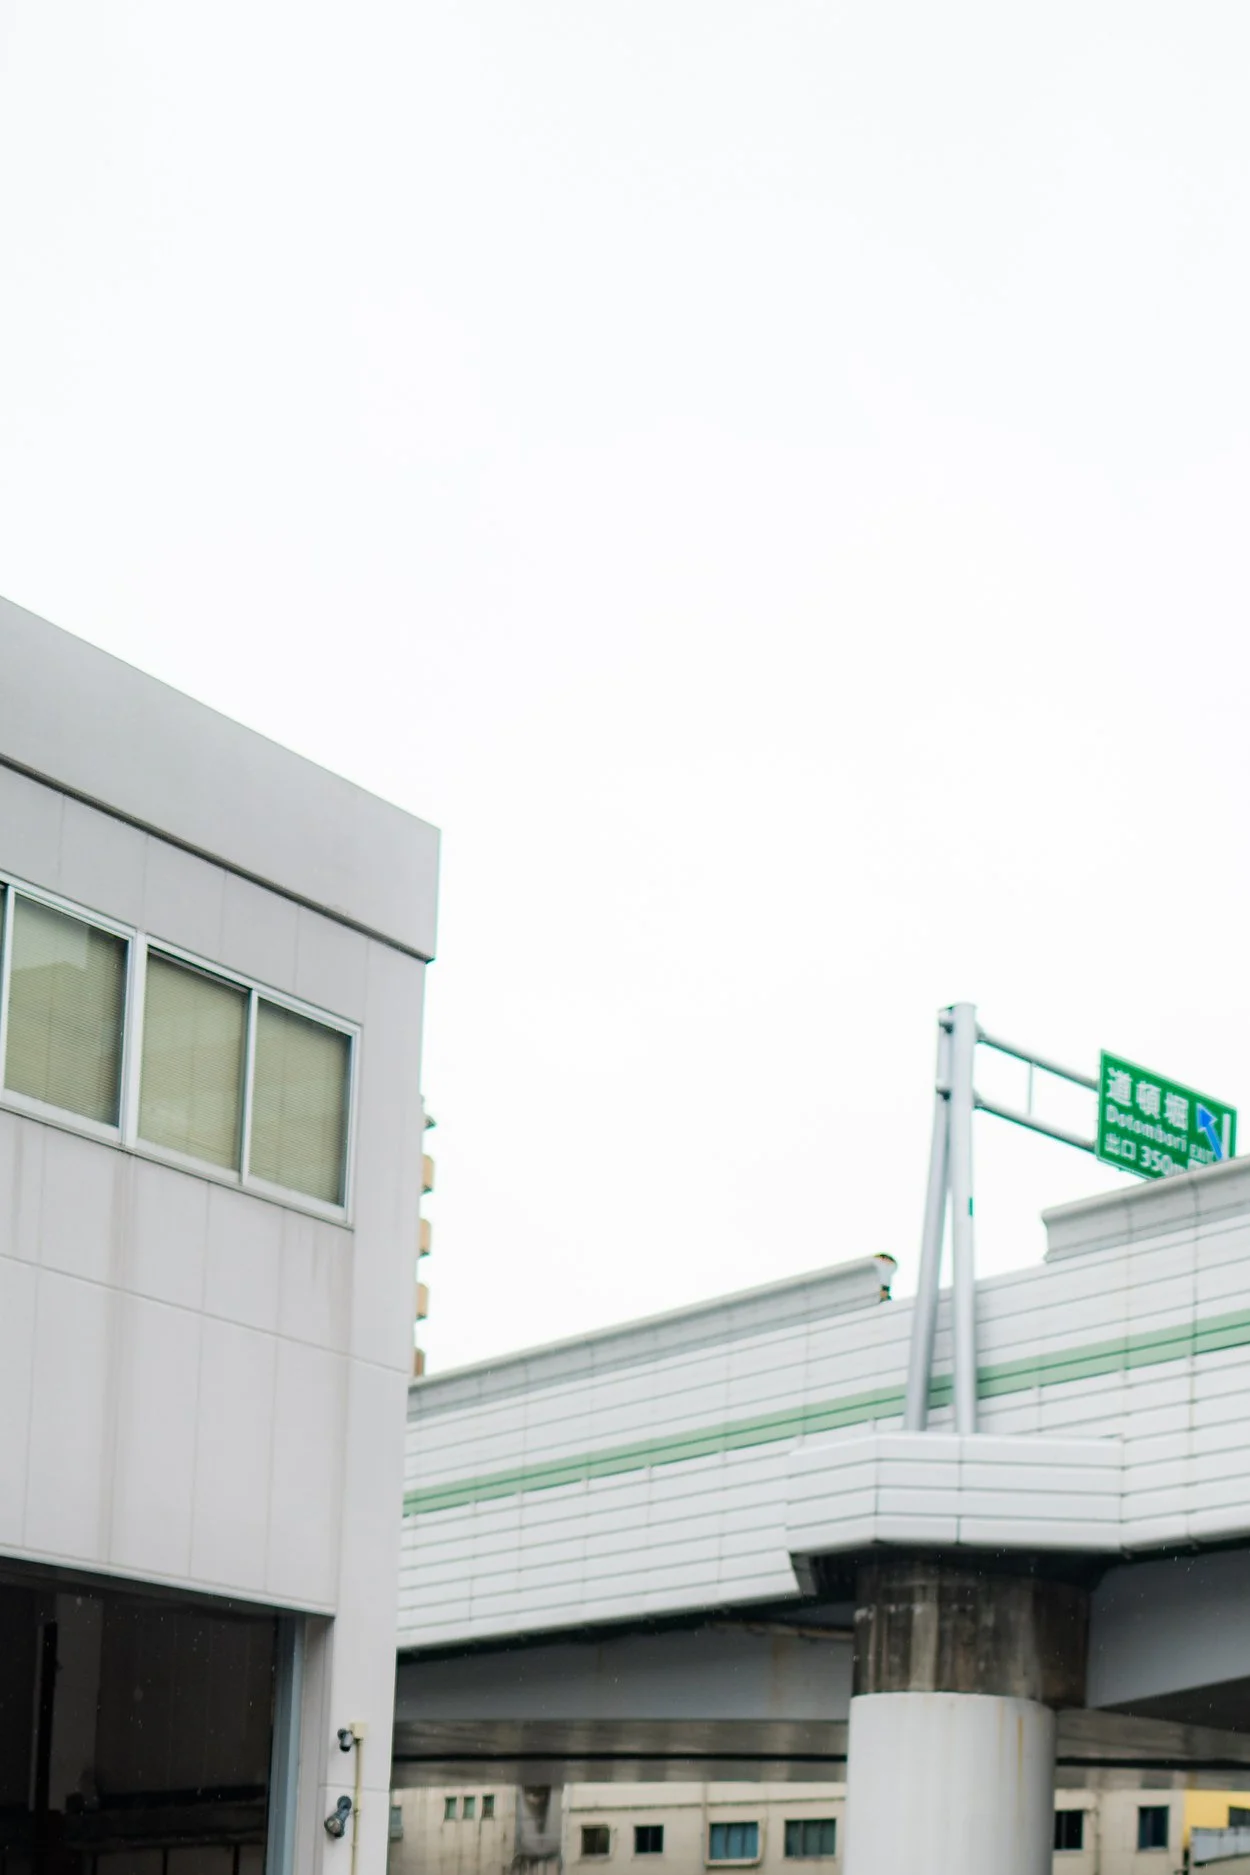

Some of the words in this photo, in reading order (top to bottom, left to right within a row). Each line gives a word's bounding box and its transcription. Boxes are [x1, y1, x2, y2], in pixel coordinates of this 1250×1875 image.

[1107, 1067, 1188, 1130] 道頓堀
[1104, 1133, 1137, 1160] 出口
